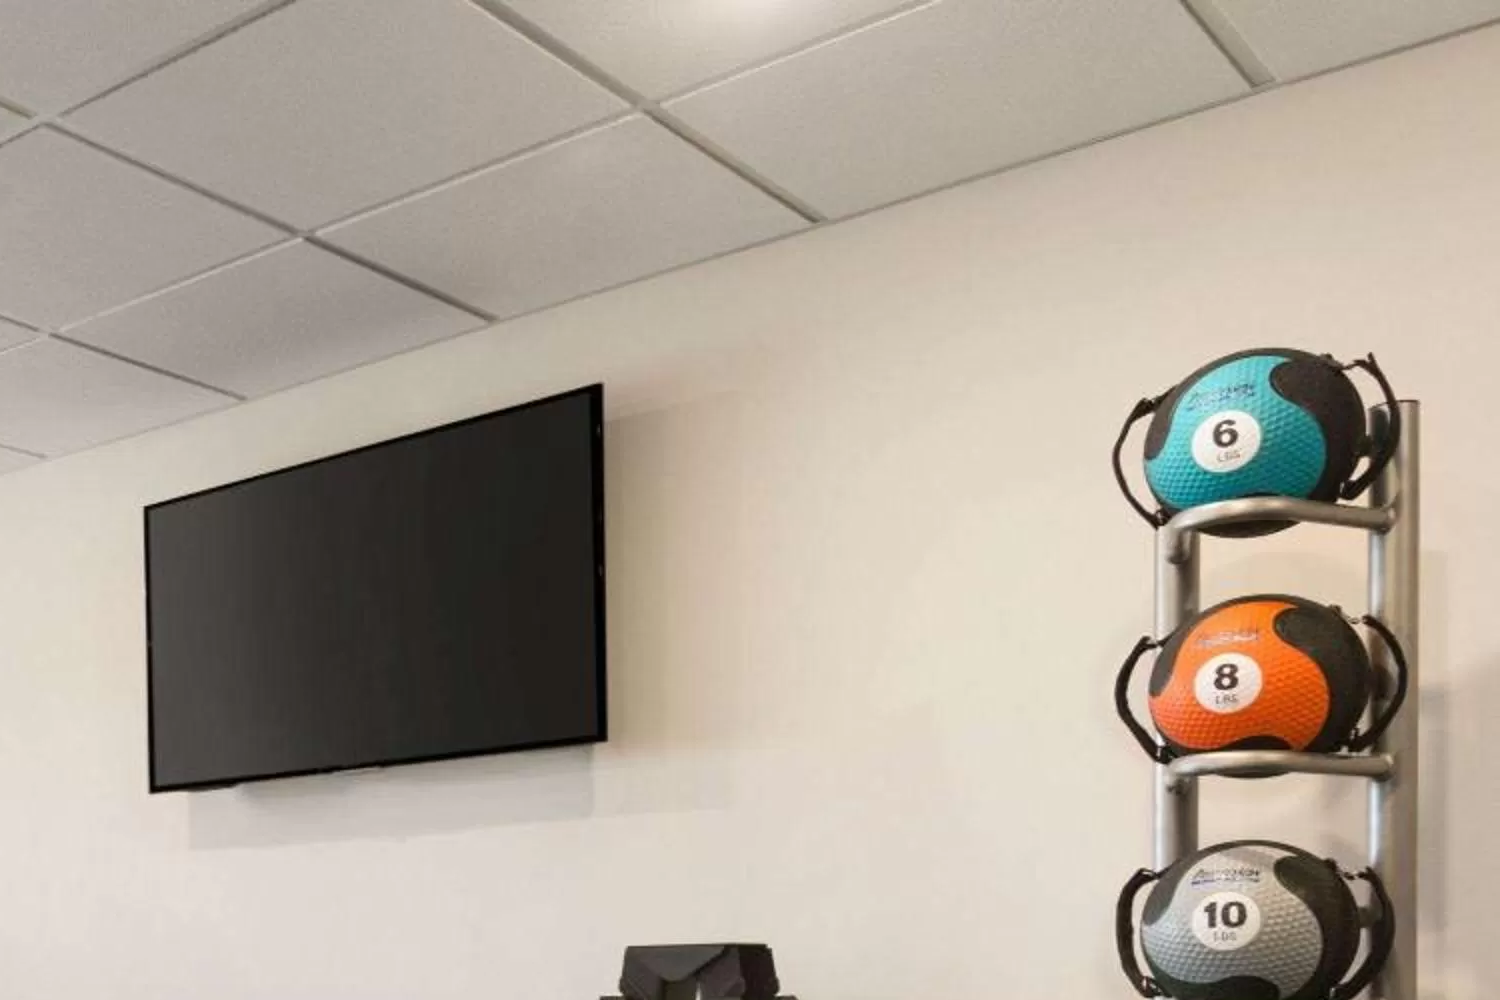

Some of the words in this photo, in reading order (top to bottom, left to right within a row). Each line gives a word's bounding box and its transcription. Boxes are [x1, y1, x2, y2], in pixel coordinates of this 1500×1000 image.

[1213, 418, 1239, 448] 6
[1214, 663, 1239, 691] 8
[1204, 901, 1247, 929] 10
